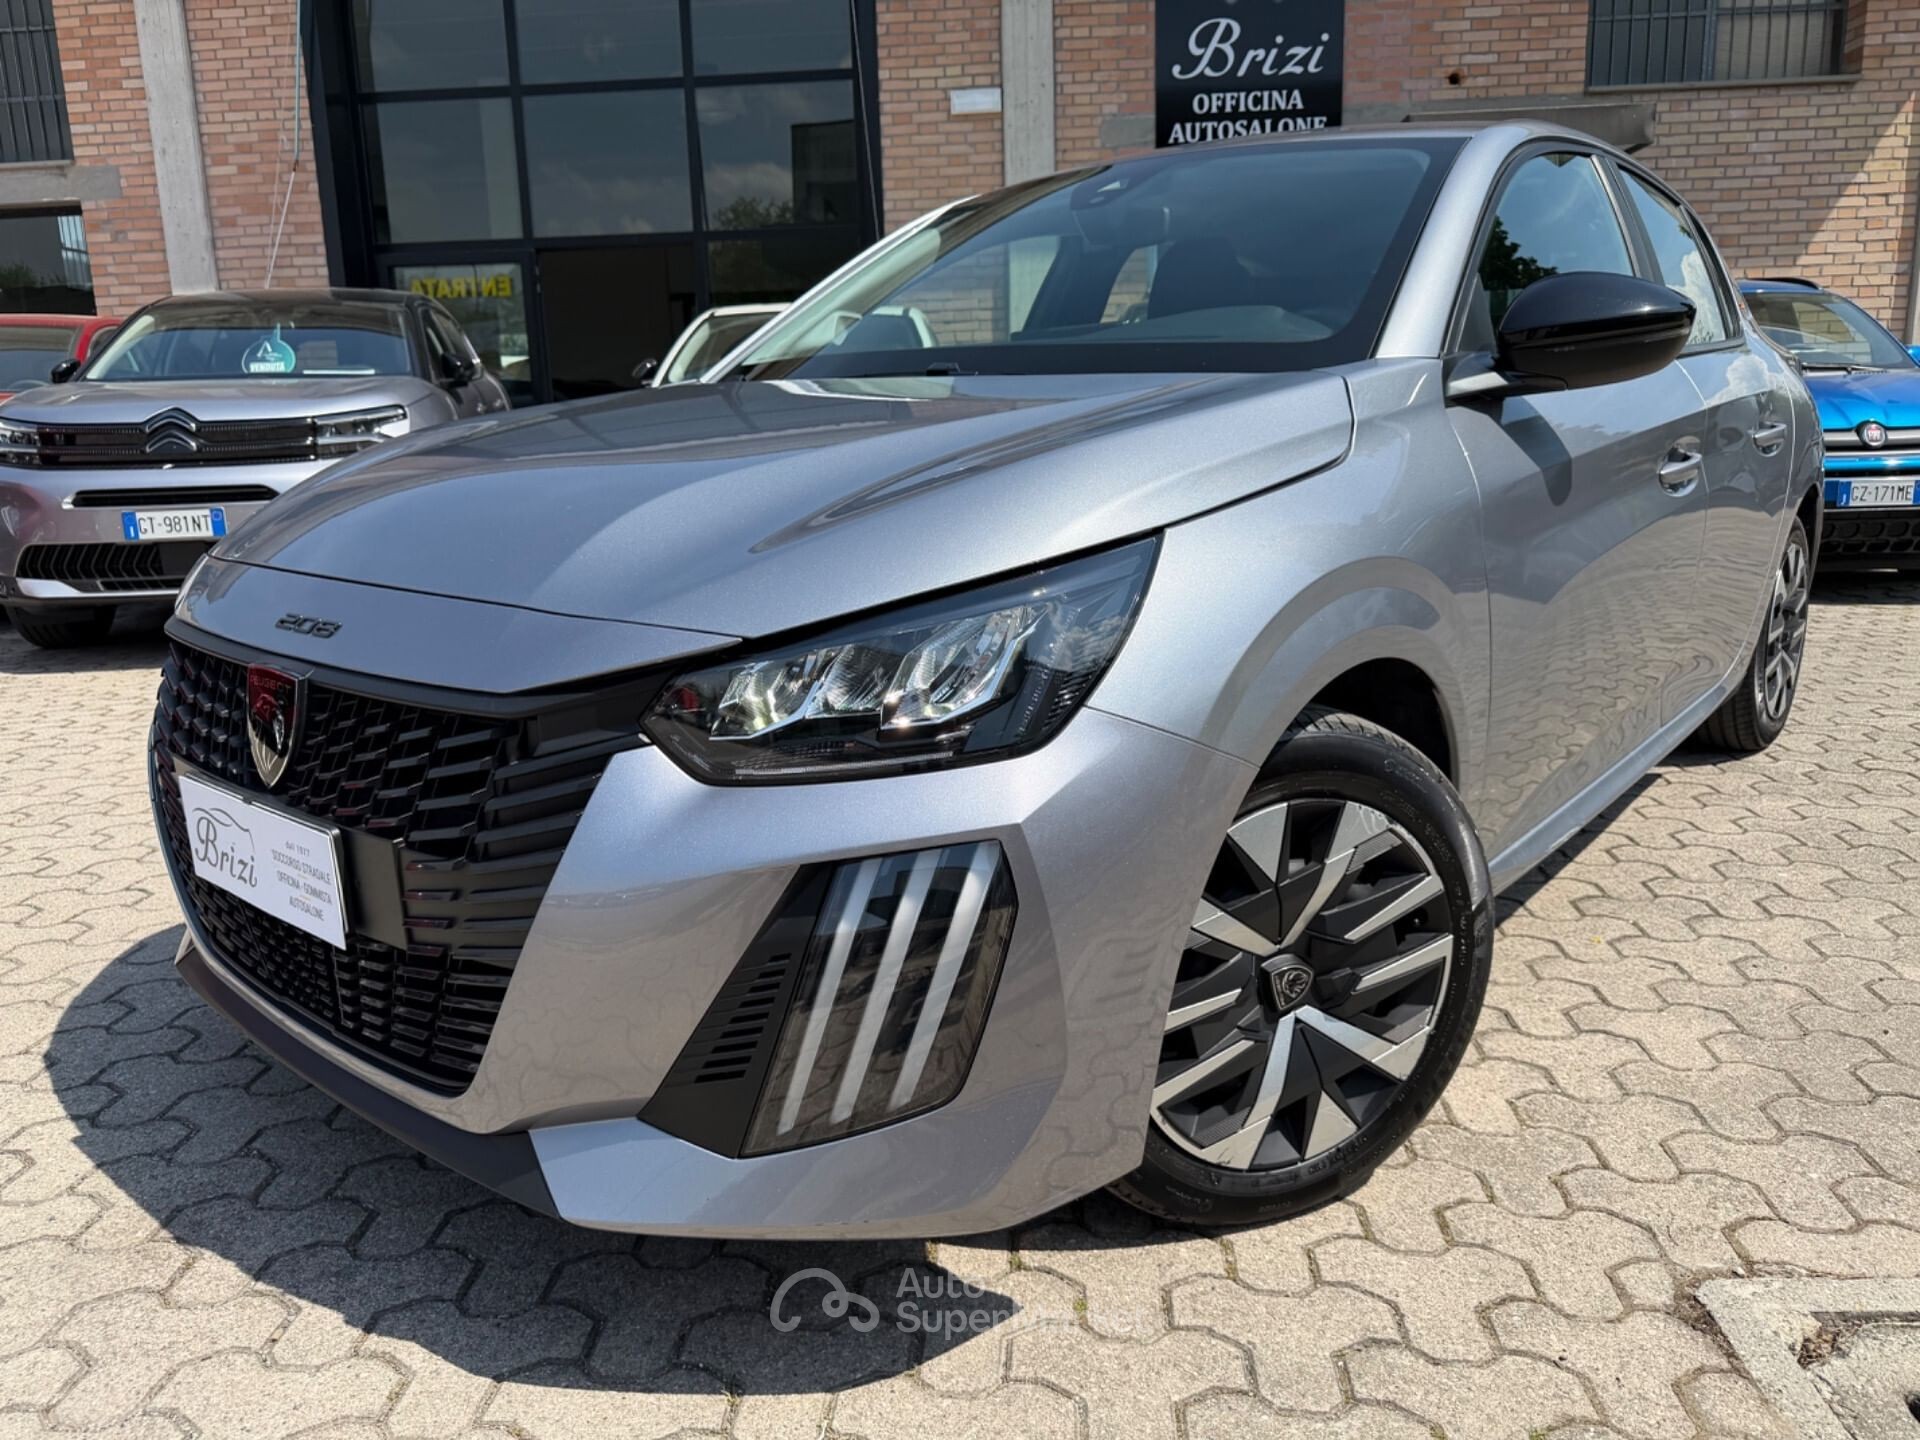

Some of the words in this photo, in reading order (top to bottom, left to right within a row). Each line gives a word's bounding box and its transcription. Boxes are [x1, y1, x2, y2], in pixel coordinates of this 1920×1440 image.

[1171, 18, 1330, 80] Brizi
[1192, 89, 1304, 115] OFFICINA
[1167, 116, 1328, 144] AUTOSALONE
[275, 613, 343, 639] 208
[194, 815, 258, 888] Brizi
